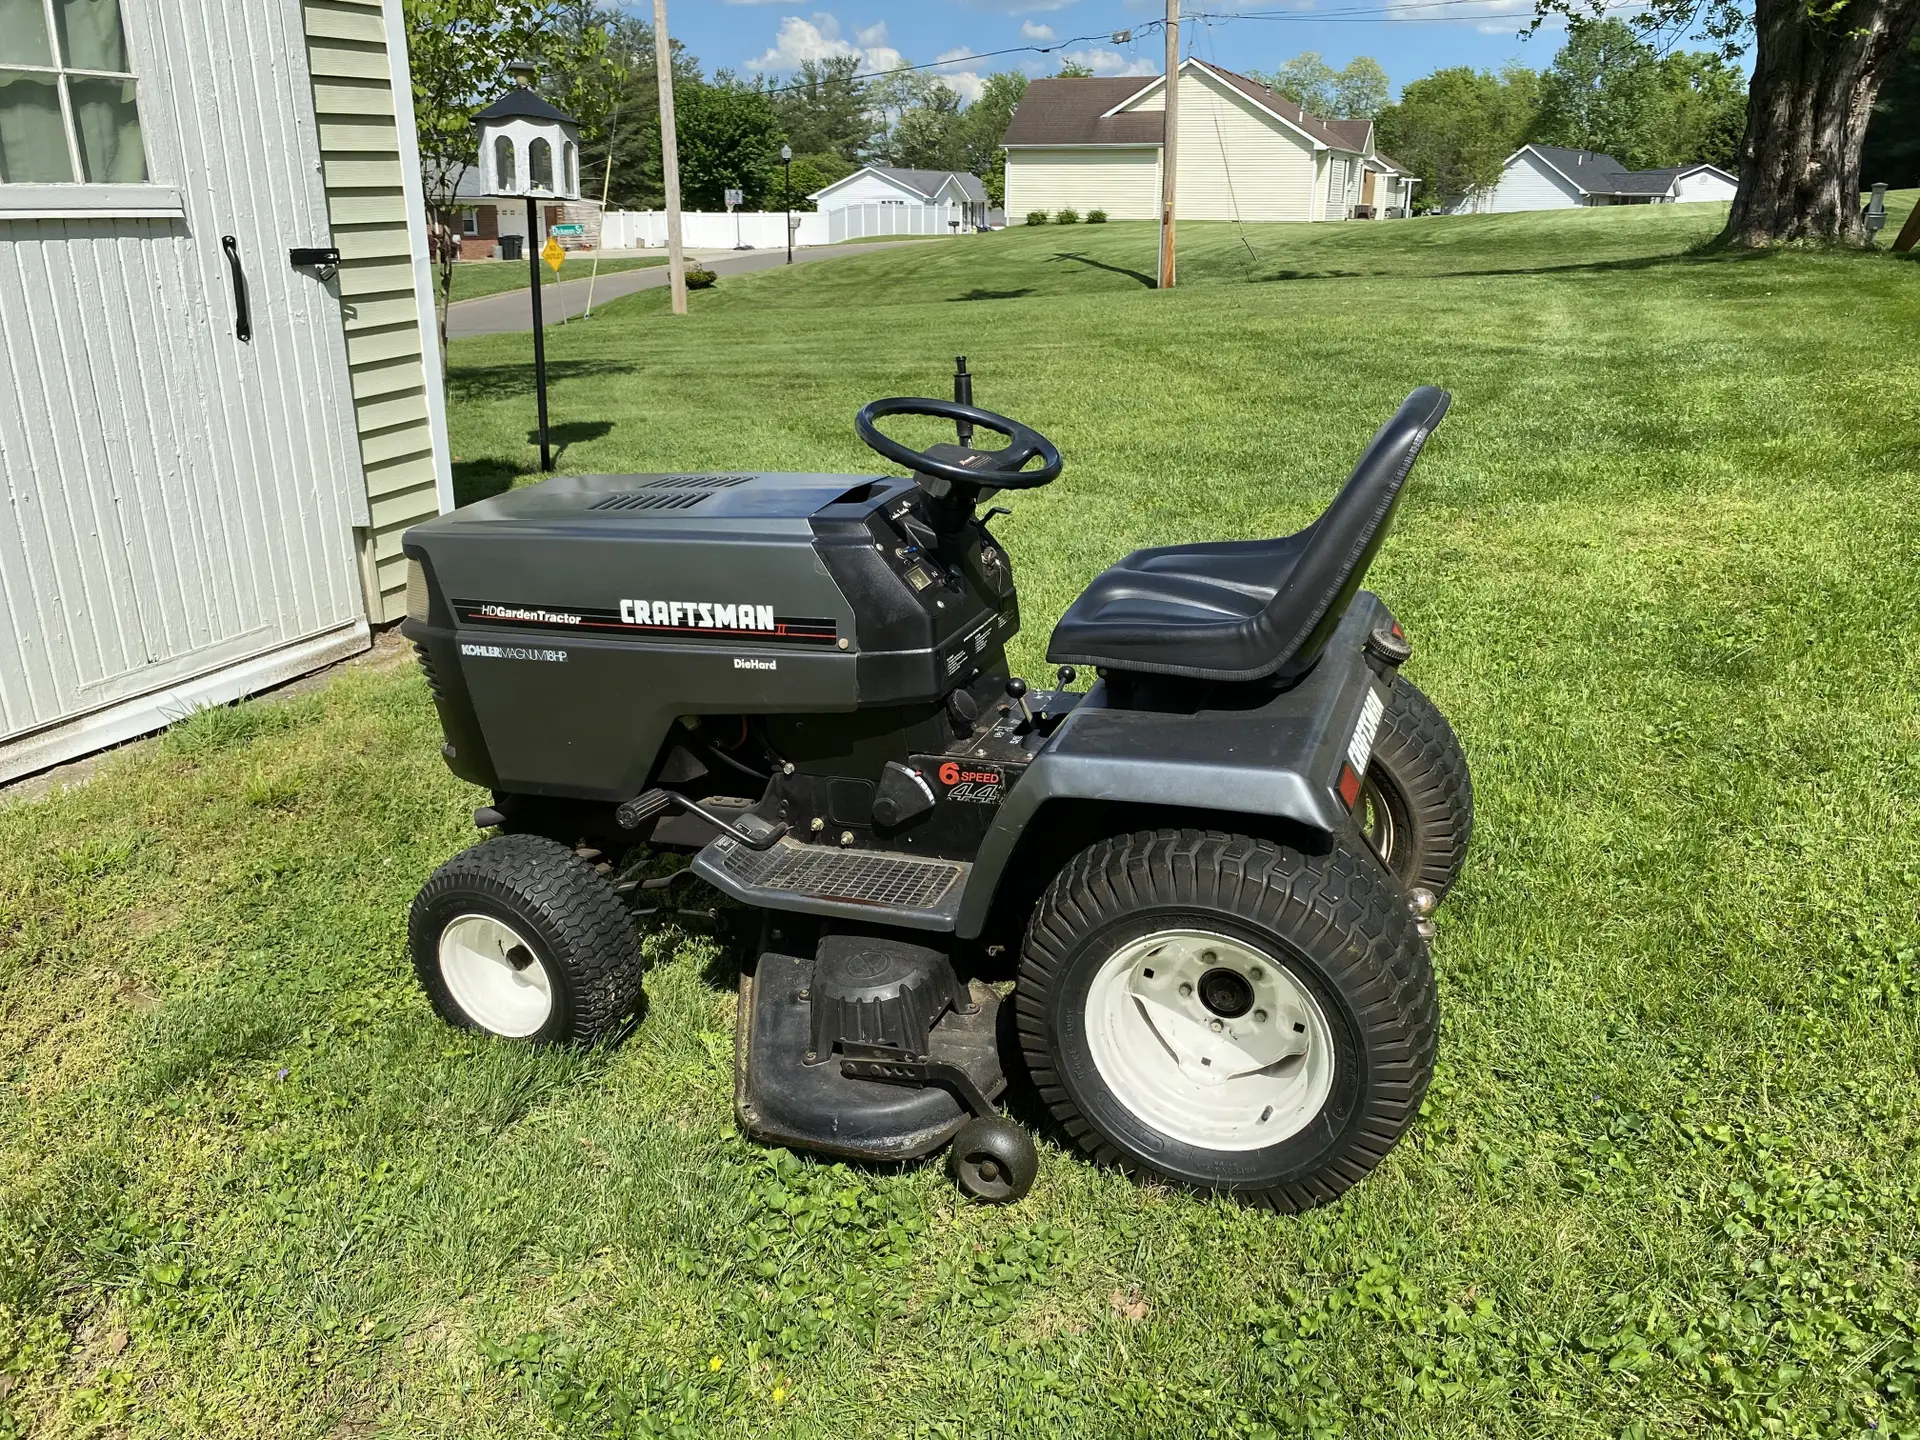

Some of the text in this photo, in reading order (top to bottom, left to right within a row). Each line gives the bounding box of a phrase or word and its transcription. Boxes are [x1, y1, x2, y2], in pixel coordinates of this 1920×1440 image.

[619, 598, 775, 631] CRAFTSMAN
[733, 658, 777, 670] DieHard
[1346, 686, 1385, 776] CRAFTSMAN
[938, 761, 1000, 786] 6 SPEED
